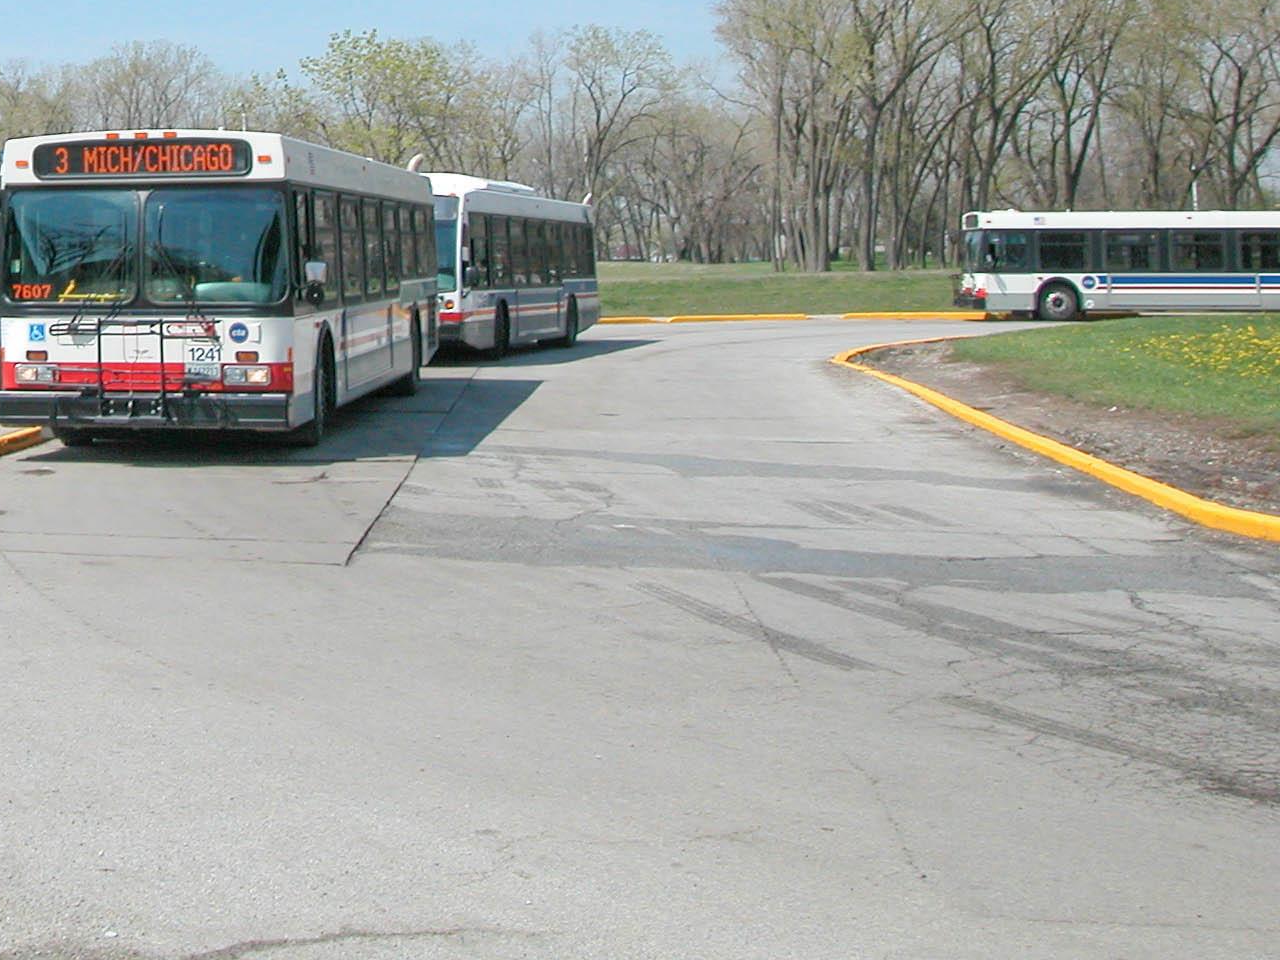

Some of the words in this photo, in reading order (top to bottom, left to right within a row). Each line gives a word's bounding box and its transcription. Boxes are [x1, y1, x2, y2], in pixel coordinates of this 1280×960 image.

[55, 147, 69, 174] 3
[83, 144, 233, 173] MICH/CHICAGO
[12, 284, 51, 299] 7607
[188, 347, 222, 362] 1241
